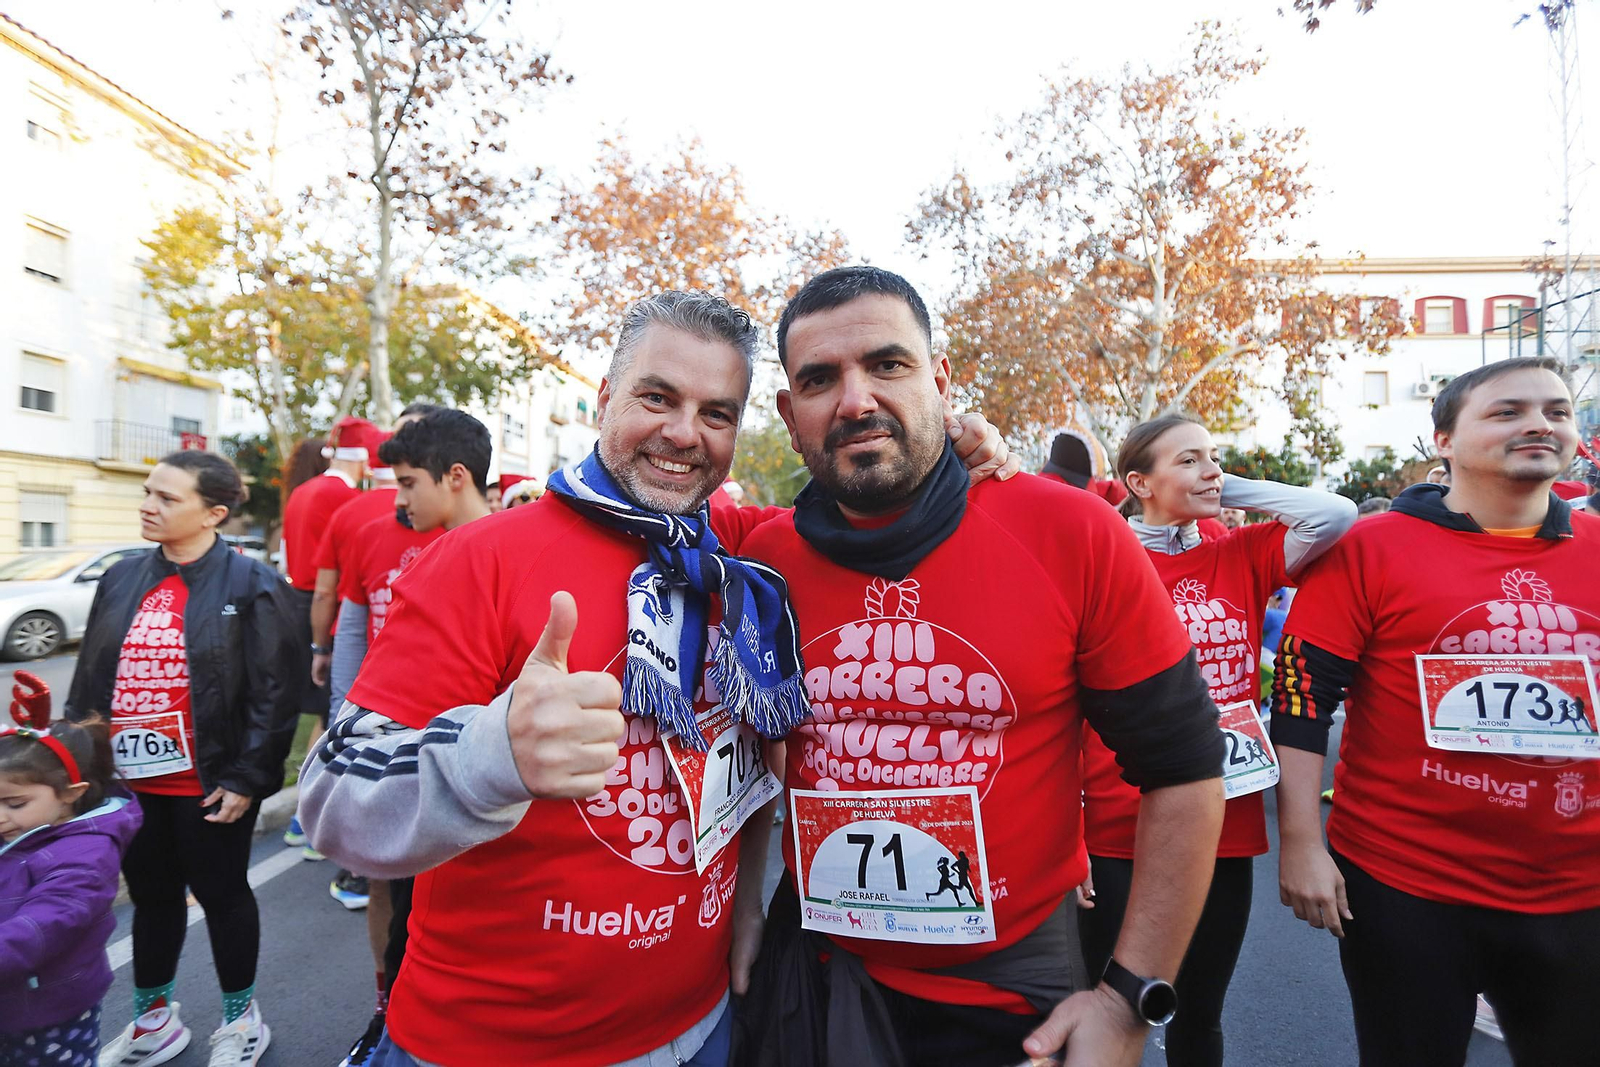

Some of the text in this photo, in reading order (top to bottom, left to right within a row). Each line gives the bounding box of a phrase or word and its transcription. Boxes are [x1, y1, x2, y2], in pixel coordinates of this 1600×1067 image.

[1486, 602, 1577, 632] XIII
[834, 622, 935, 663] XIII
[1196, 644, 1246, 662] LVEST
[1440, 627, 1600, 660] CARRER
[803, 661, 1002, 711] ARRERA
[111, 690, 171, 713] 2023
[1465, 681, 1554, 722] 173
[117, 732, 159, 756] 476
[816, 719, 1000, 763] HUELVA
[1225, 732, 1247, 766] 2
[717, 734, 746, 797] 70
[828, 758, 855, 783] DE
[857, 757, 988, 787] DICIEMBRE
[1422, 759, 1526, 799] Huelva
[586, 788, 678, 819] 30 DE
[823, 798, 932, 809] XIII CARRERA SAN SILVESTRE
[853, 809, 896, 819] DE HUELVA
[1487, 795, 1526, 809] original
[628, 816, 693, 866] 20
[806, 827, 811, 836] L
[846, 833, 907, 891] 71
[839, 890, 858, 899] JOSE
[859, 892, 891, 902] RAFAEL
[543, 899, 676, 937] Huelva
[814, 912, 842, 923] ONUFER
[923, 925, 955, 934] Huelva
[629, 930, 671, 949] original
